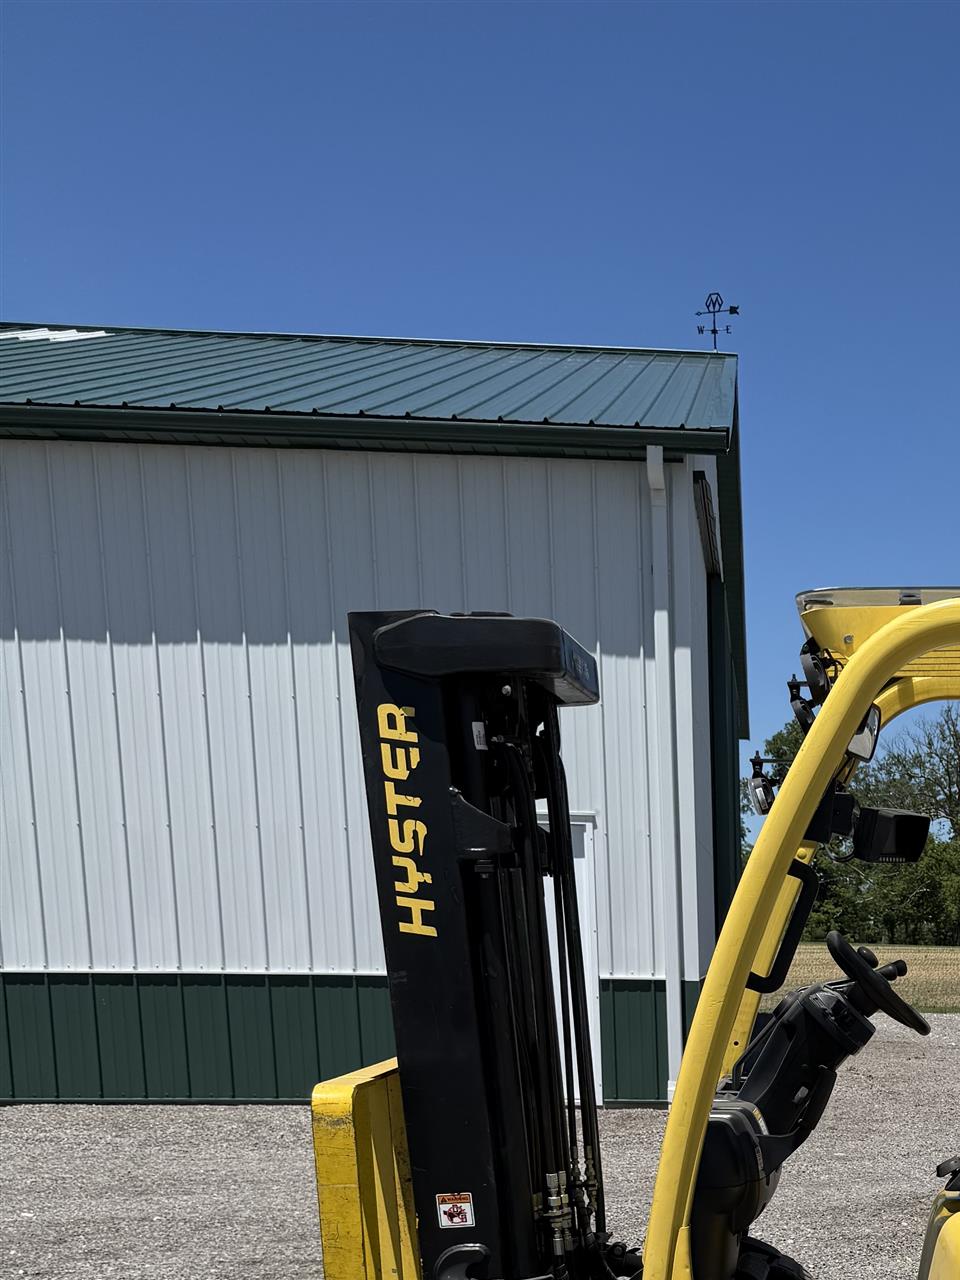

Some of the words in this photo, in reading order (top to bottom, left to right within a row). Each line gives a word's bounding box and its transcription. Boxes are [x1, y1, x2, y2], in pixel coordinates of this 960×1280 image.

[697, 325, 705, 335] W
[726, 325, 732, 334] E
[377, 703, 438, 938] HYSTER
